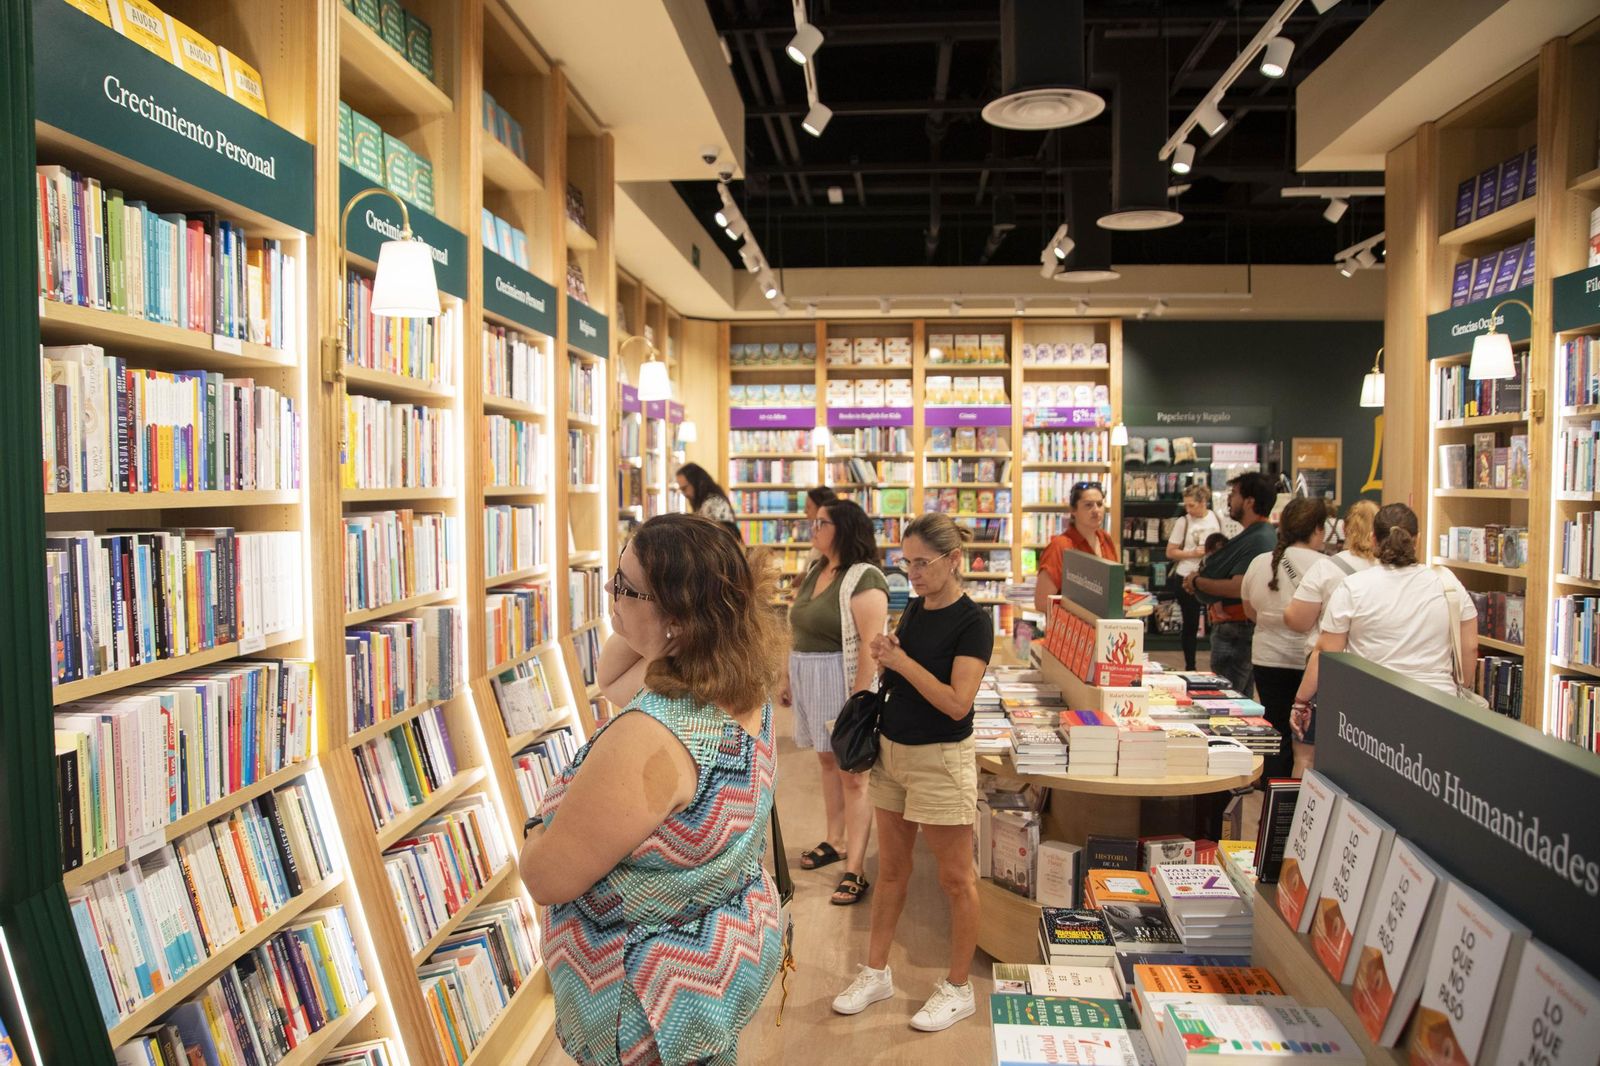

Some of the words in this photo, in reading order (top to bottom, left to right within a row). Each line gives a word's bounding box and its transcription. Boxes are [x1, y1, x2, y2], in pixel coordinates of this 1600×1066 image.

[131, 7, 160, 35] AUDAZ
[189, 43, 214, 67] AUDAZ
[103, 74, 214, 149] Crecimiento
[216, 130, 277, 181] Personal
[1451, 320, 1478, 337] Ciencias
[1157, 412, 1197, 423] Papelería
[1196, 413, 1201, 423] y
[1202, 411, 1231, 423] Regalo
[118, 416, 128, 475] CASUALIDAD
[116, 582, 121, 590] YO
[1308, 798, 1317, 813] LO
[1337, 711, 1442, 799] Recomendados
[1443, 770, 1600, 898] Humanidades
[1301, 810, 1315, 831] QUE
[1299, 828, 1309, 844] NO
[1349, 831, 1359, 849] LO
[1095, 853, 1128, 862] HISTORIA
[1292, 838, 1307, 862] PASÓ
[1342, 847, 1358, 870] QUE
[1202, 876, 1230, 890] 7
[1339, 866, 1351, 884] NO
[1399, 874, 1410, 895] LO
[1332, 877, 1349, 903] PASÓ
[1391, 891, 1407, 918] QUE
[1386, 910, 1398, 933] NO
[1377, 924, 1394, 956] PASÓ
[1461, 926, 1476, 951] LO
[1452, 945, 1475, 978] QUE
[1448, 968, 1465, 995] NO
[1035, 999, 1050, 1027] PERTENEC
[1053, 1004, 1062, 1013] NO
[1438, 983, 1464, 1022] PASÓ
[1543, 995, 1564, 1027] LO
[1055, 1014, 1066, 1025] ME
[1069, 1004, 1083, 1026] HERIDA
[1086, 1008, 1099, 1023] ESTA
[1036, 1034, 1059, 1065] propio
[1531, 1017, 1563, 1060] QUE
[1062, 1039, 1080, 1065] amor
